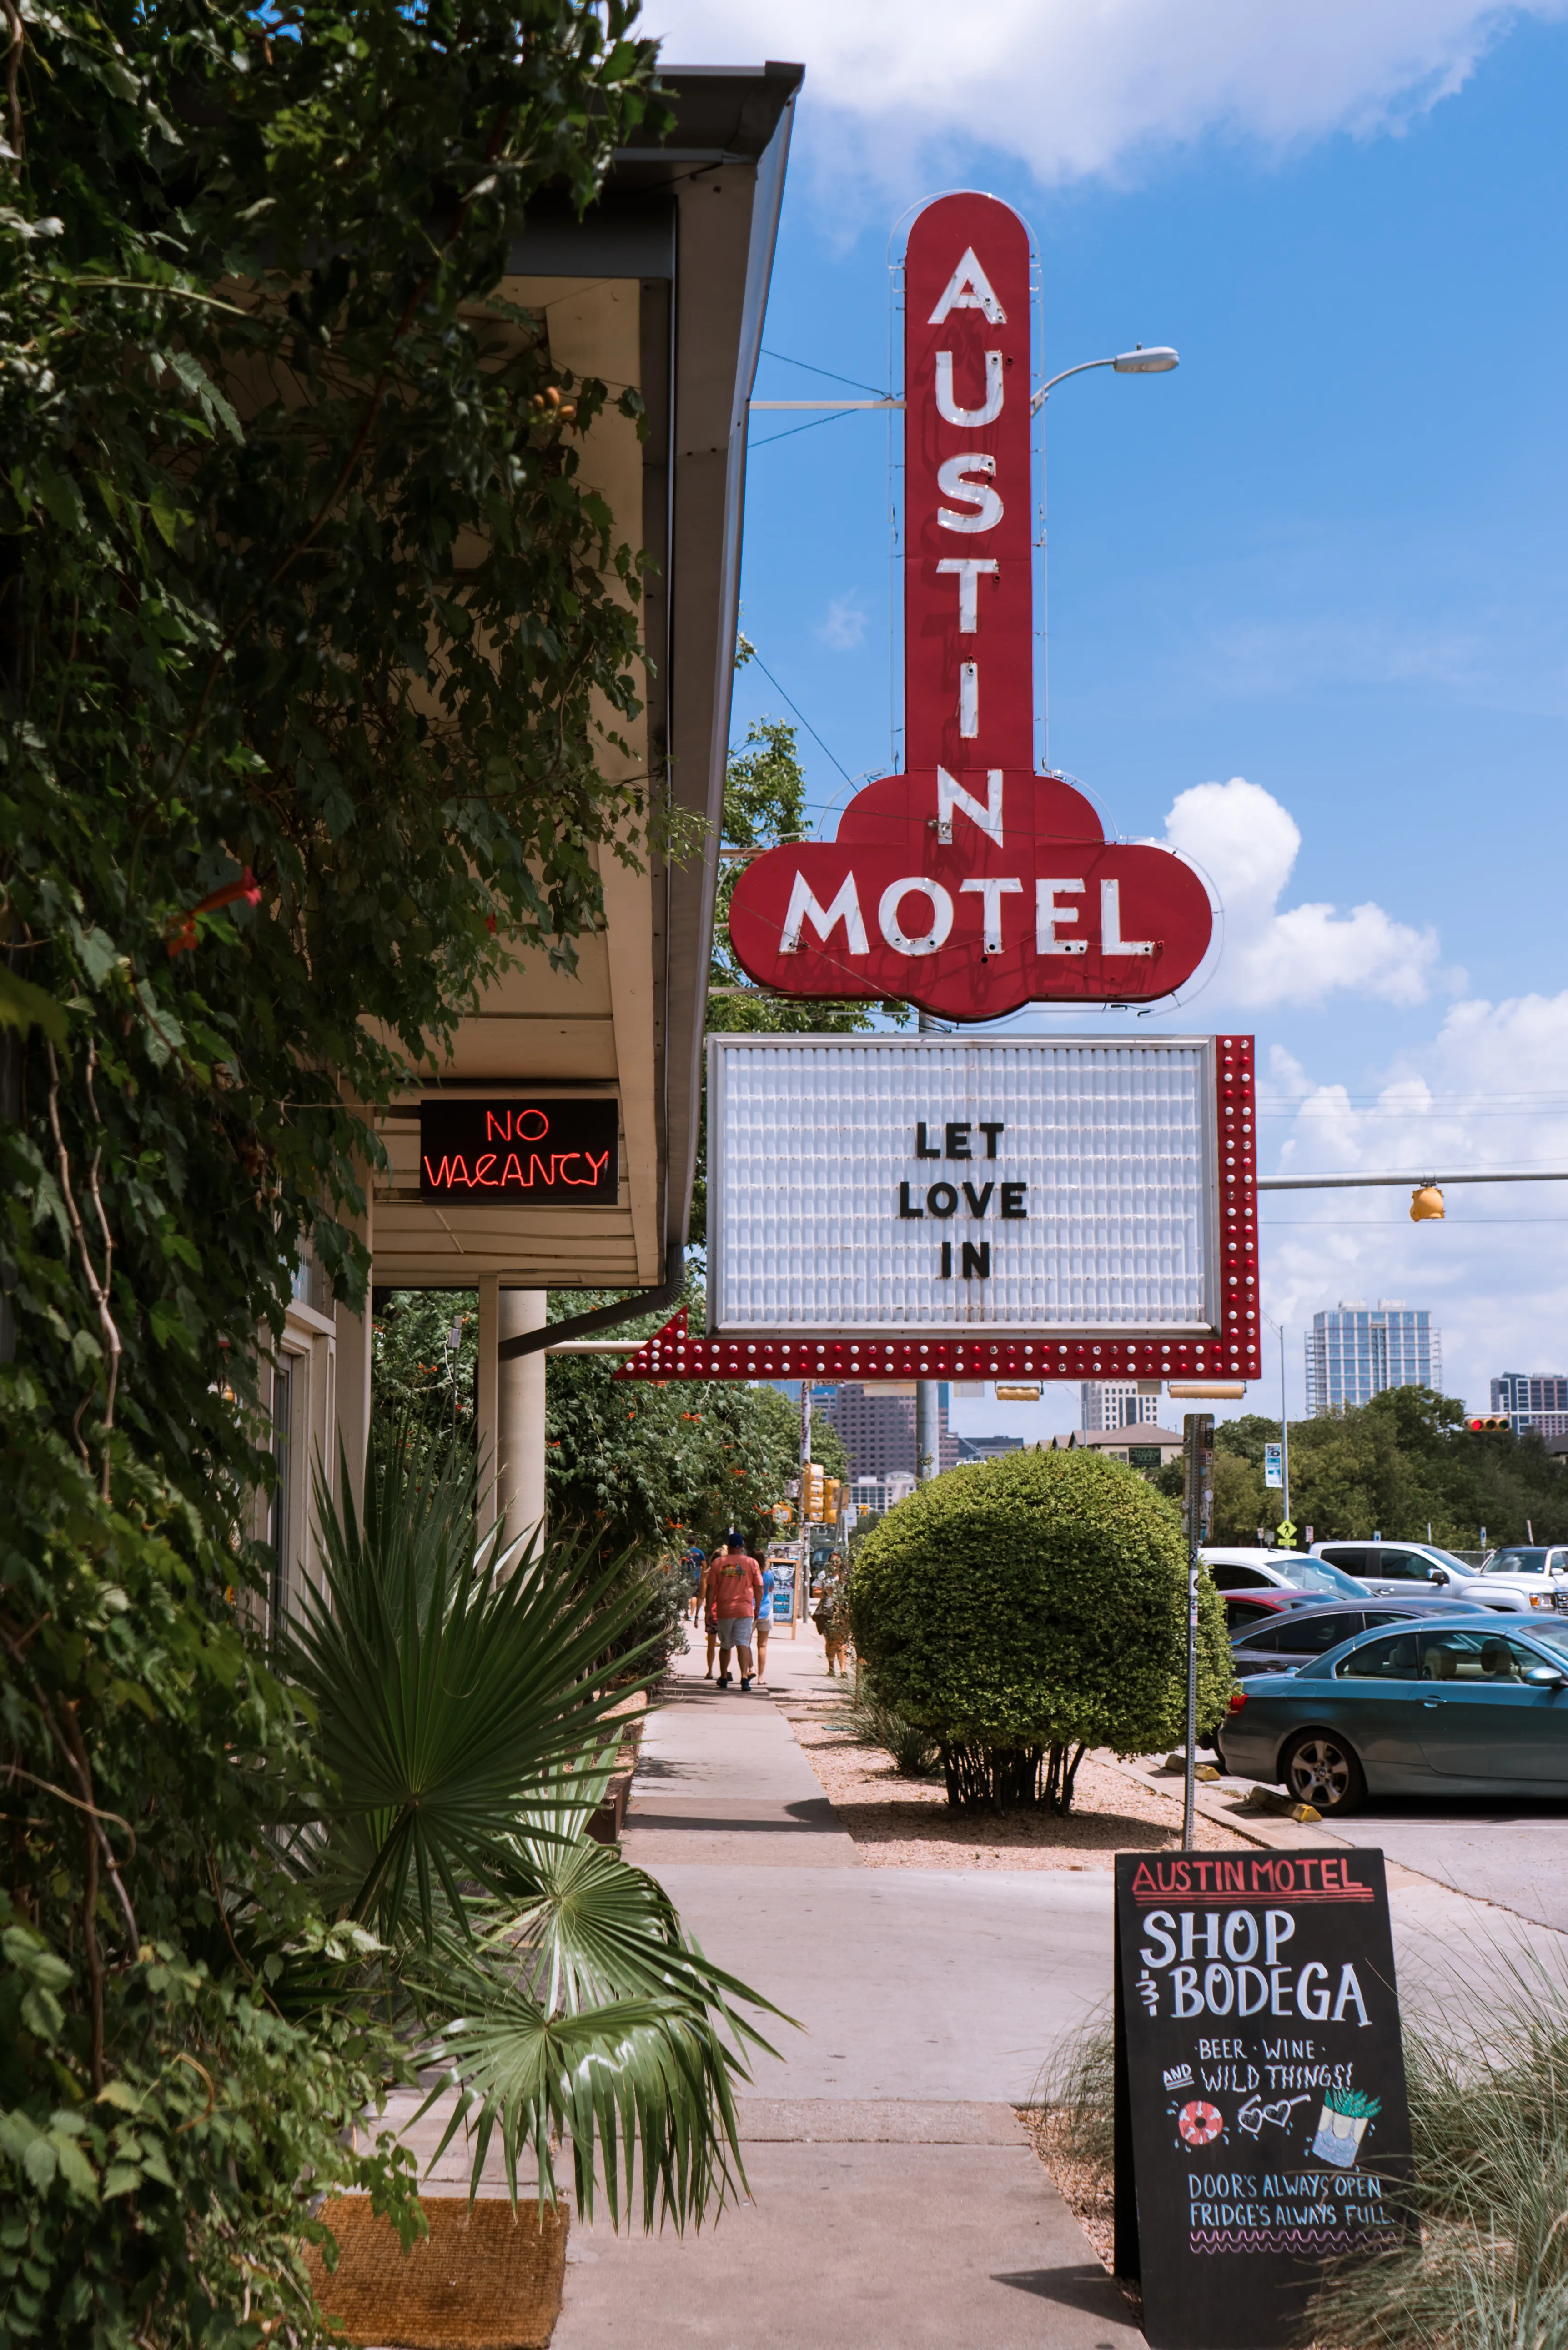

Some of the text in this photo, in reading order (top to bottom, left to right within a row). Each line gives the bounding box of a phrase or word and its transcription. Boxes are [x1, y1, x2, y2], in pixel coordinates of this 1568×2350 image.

[927, 246, 1007, 849] AUSTIN
[778, 869, 1156, 957] MOTEL
[487, 1109, 549, 1141] NO
[917, 1122, 1004, 1159] LET
[424, 1151, 609, 1188] VACANCY
[900, 1181, 1027, 1218] LOVE
[941, 1241, 990, 1278] IN
[1132, 1858, 1363, 1892] AUSTIN MOTEL
[1139, 1909, 1295, 1968] SHOP
[1168, 1962, 1373, 2027] BODEGA
[1199, 2038, 1315, 2059] BEER WINE
[1162, 2062, 1353, 2093] AND WILD THINGS!
[1188, 2174, 1382, 2199] DOOR'S ALWAYS OPEN
[1190, 2202, 1395, 2227] FRIDGE'S ALWAYS FULL.
